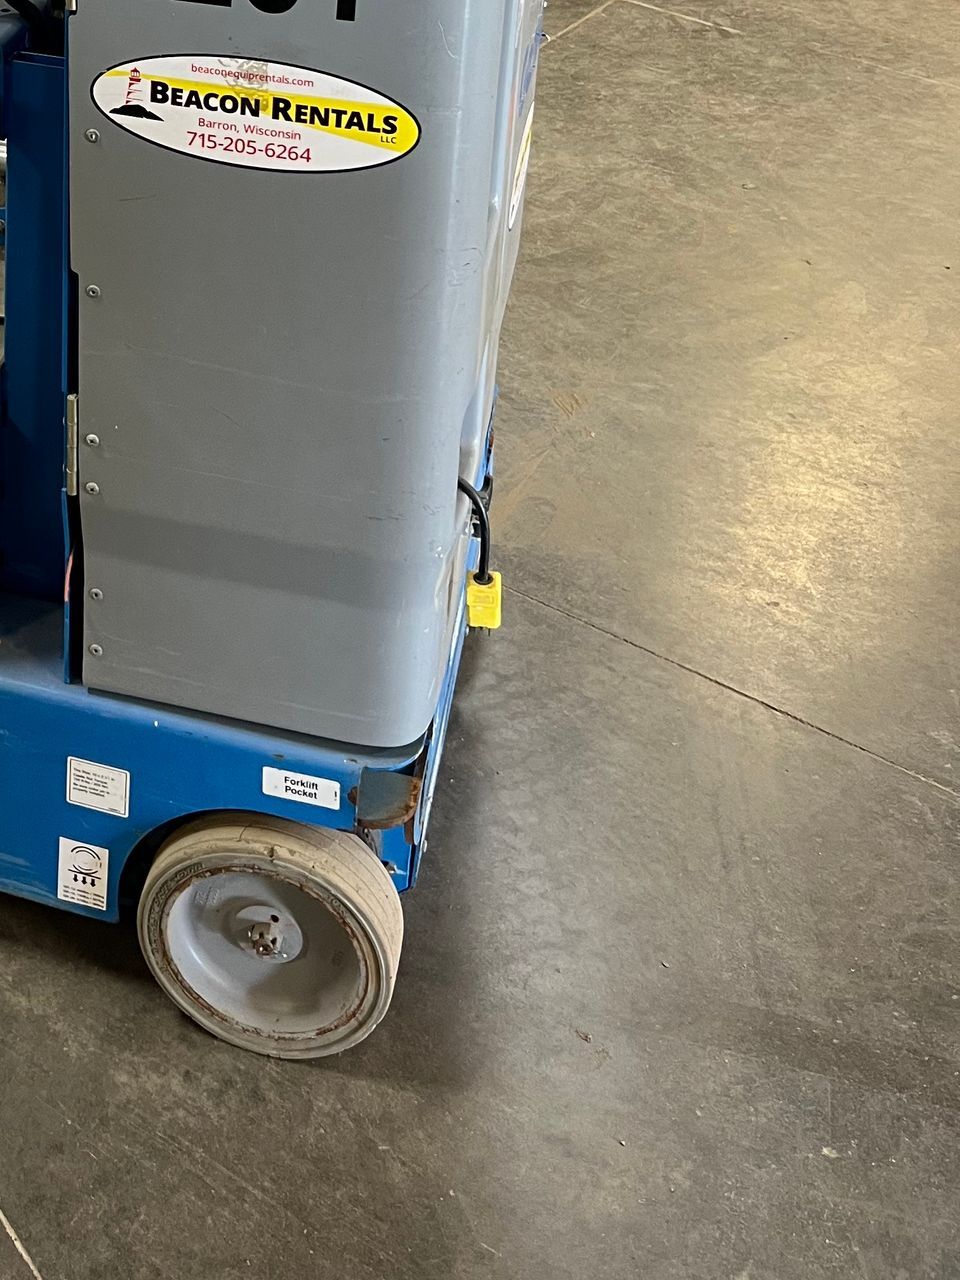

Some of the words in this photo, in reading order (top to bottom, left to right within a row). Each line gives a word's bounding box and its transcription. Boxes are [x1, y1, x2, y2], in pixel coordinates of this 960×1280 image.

[190, 63, 315, 88] beaconequiprentals.com
[149, 80, 261, 118] BEACON
[271, 97, 398, 136] RENTALS
[197, 117, 240, 134] Barron,
[243, 122, 302, 141] Wisconsin
[380, 135, 397, 145] LLC
[185, 131, 313, 163] 715-205-6264
[284, 776, 319, 791] Forklift
[285, 785, 318, 799] Pocket
